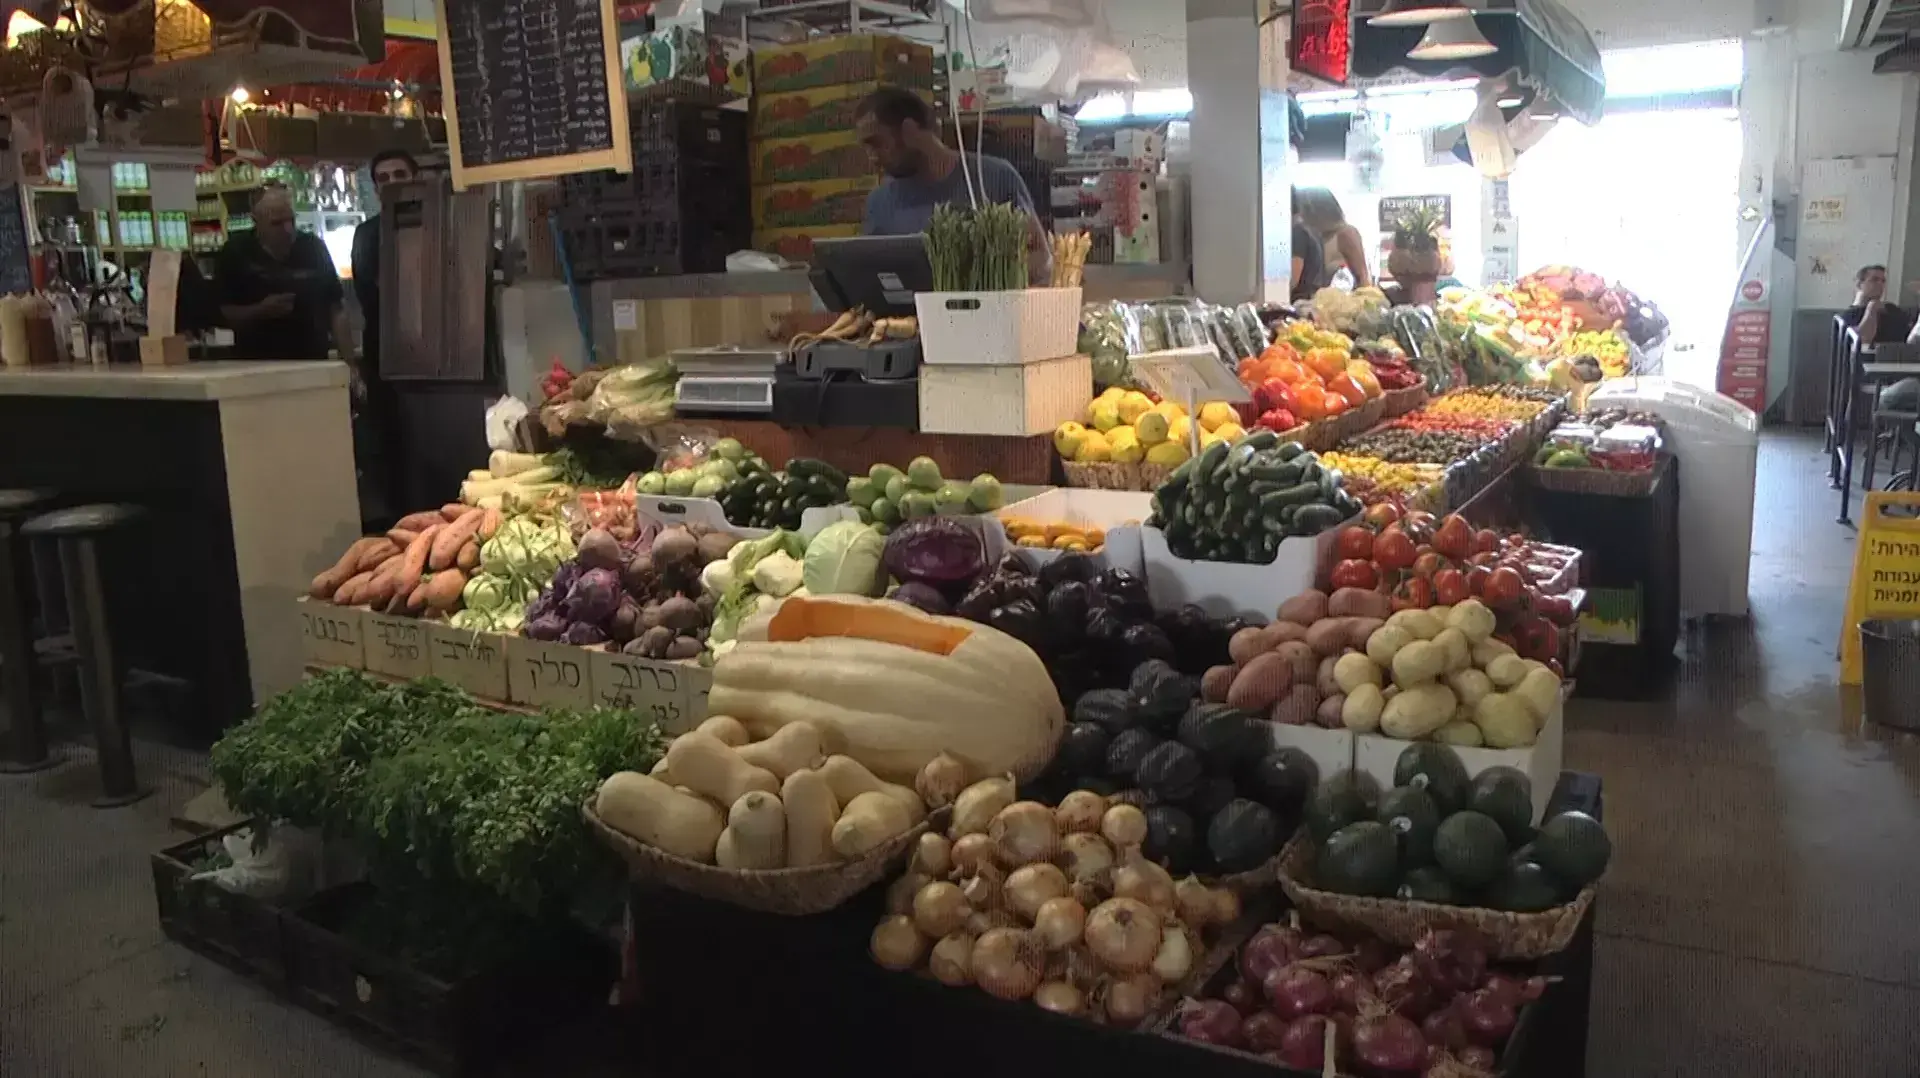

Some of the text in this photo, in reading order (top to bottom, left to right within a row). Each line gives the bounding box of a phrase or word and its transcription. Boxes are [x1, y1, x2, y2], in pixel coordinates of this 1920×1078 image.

[1871, 538, 1920, 556] הירות!
[1874, 589, 1919, 603] זמניות
[526, 651, 581, 690] סלק
[610, 662, 677, 692] כרוב
